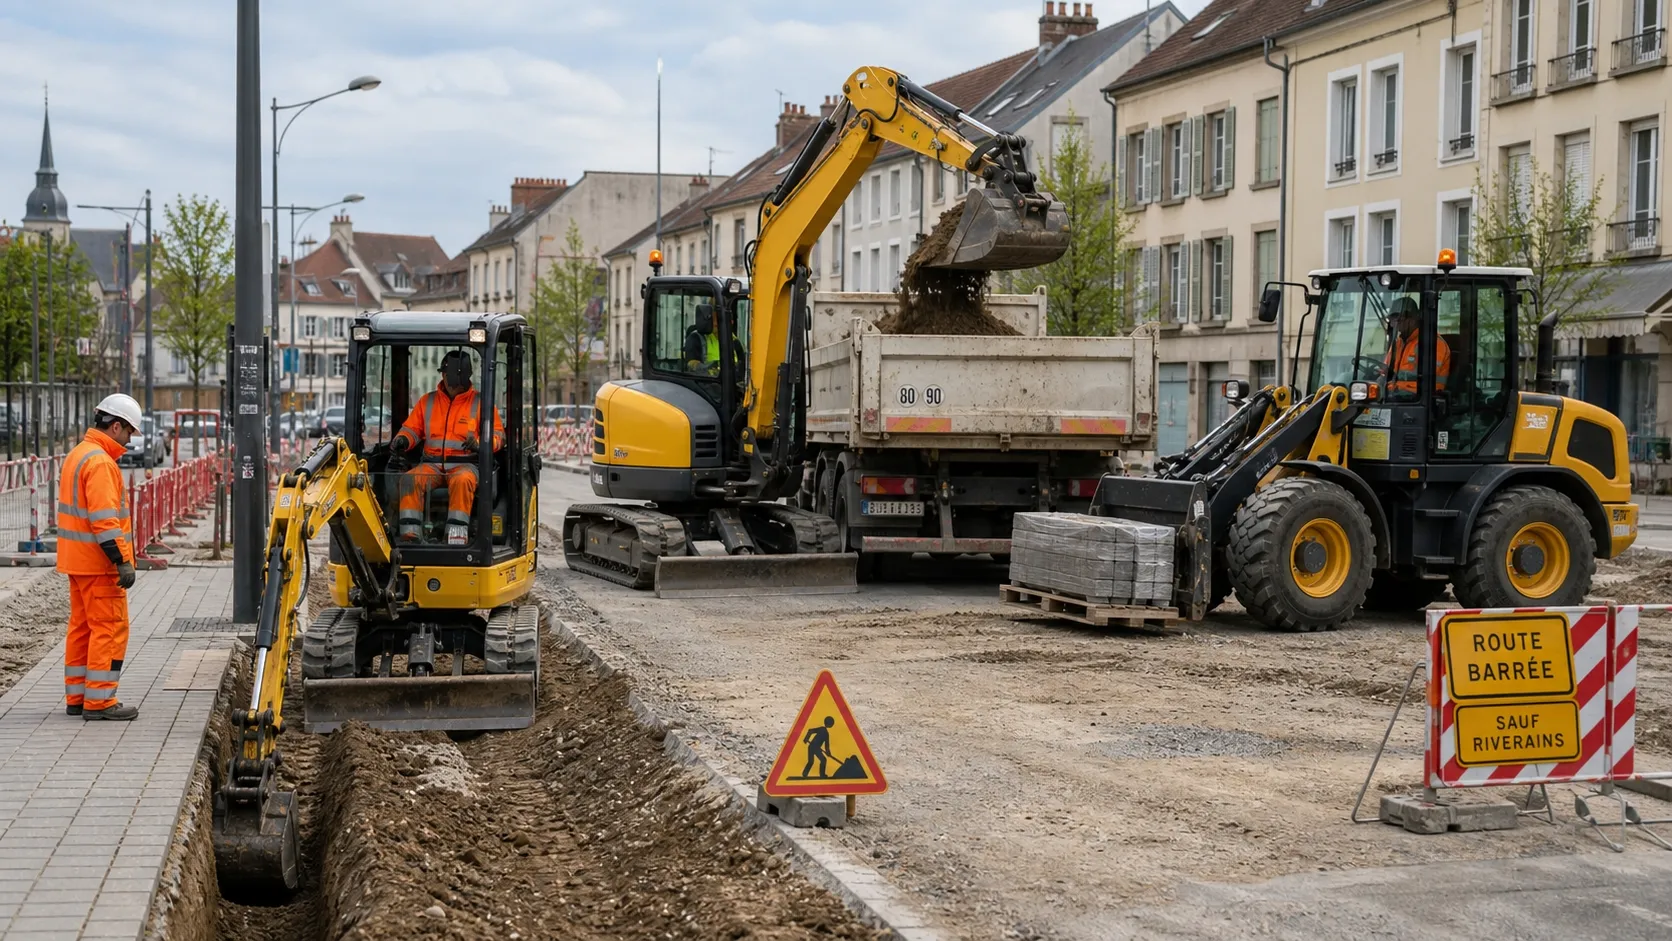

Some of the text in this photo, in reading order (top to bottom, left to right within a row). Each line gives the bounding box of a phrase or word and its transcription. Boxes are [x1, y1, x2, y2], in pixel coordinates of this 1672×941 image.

[900, 387, 915, 404] 80
[926, 387, 942, 405] 90
[1472, 632, 1543, 652] ROUTE
[1468, 656, 1554, 682] BARRÉE
[1496, 714, 1540, 730] SAUF
[1473, 733, 1565, 752] RIVERAINS
